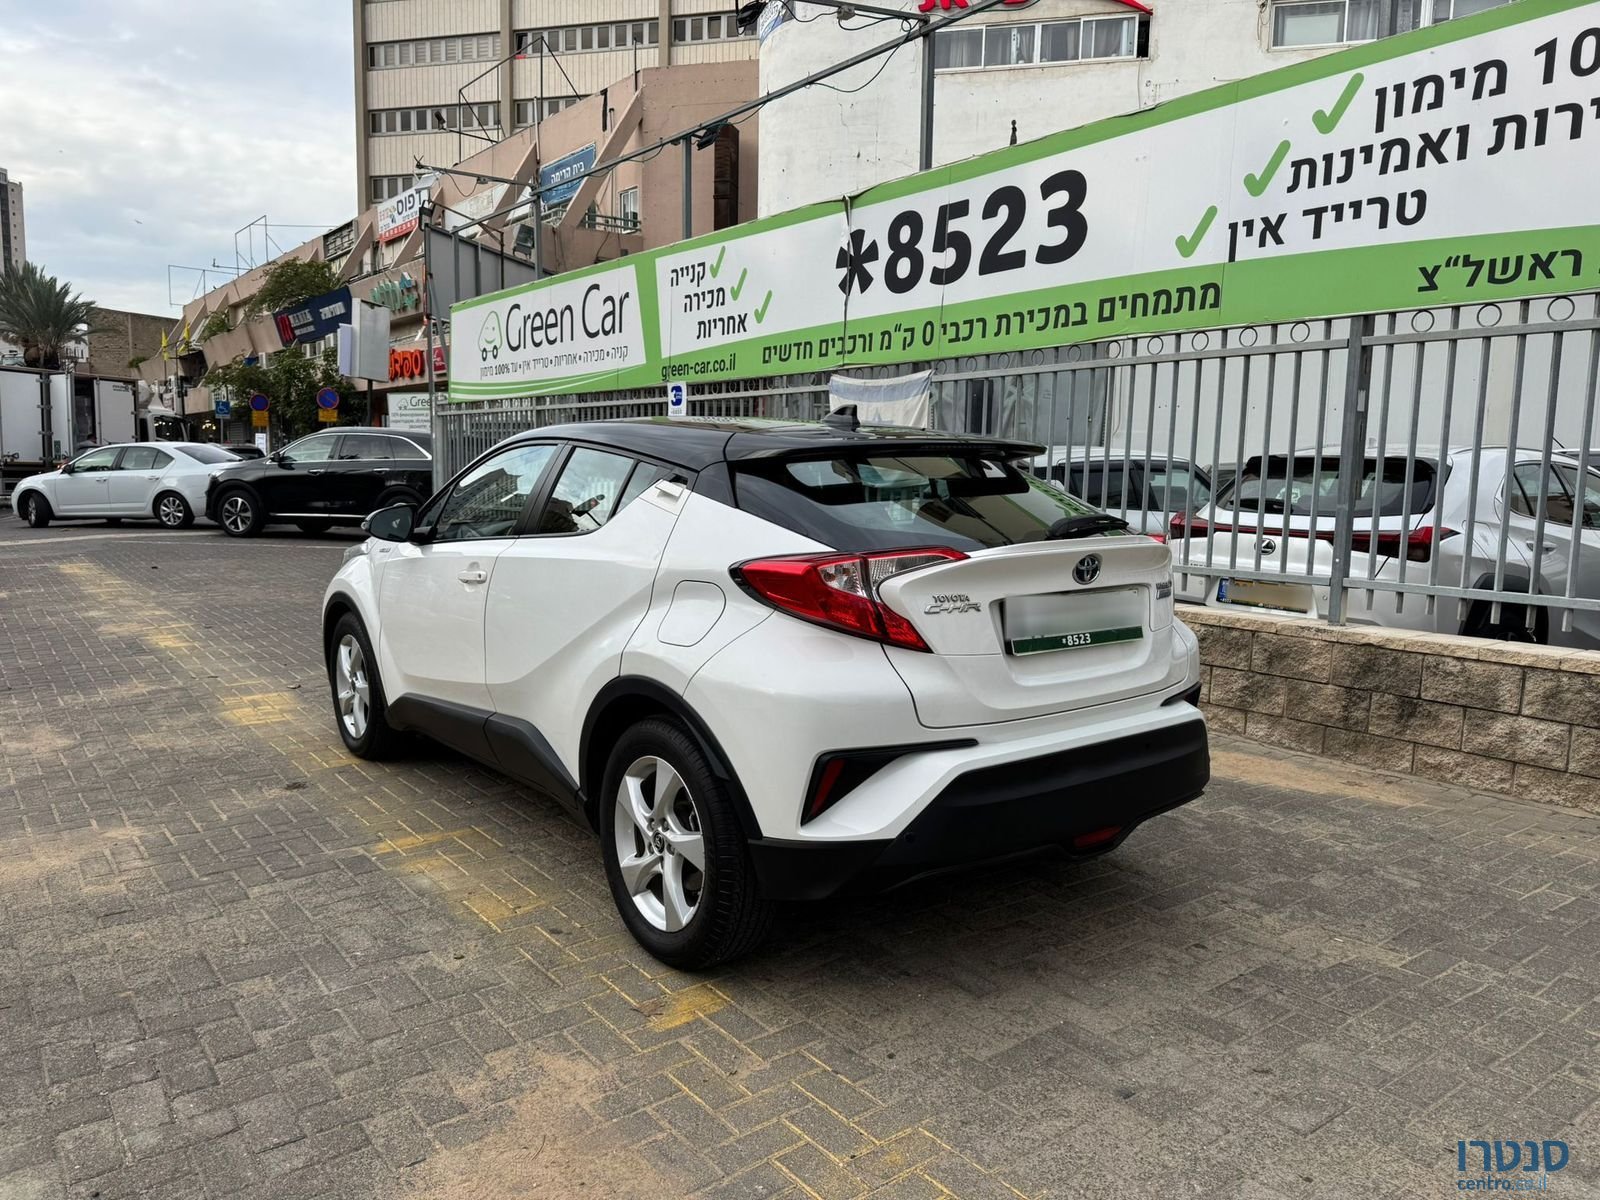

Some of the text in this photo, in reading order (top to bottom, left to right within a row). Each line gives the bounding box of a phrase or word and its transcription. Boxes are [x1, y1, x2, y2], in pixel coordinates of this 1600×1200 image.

[1374, 58, 1508, 133] מימון
[1286, 124, 1470, 194] ואמינות
[1228, 189, 1427, 263] טרייד אין
[670, 261, 706, 287] קנייה
[683, 287, 726, 313] מכירה
[1098, 282, 1221, 322] מתמחים
[506, 283, 629, 351] Green Car
[696, 313, 748, 340] אחריות
[941, 317, 987, 343] רכבי
[994, 302, 1088, 337] במכירת
[762, 341, 813, 364] חדשים
[818, 333, 874, 358] ורכבים
[661, 353, 736, 381] green-car.co.il
[409, 395, 431, 407] Gree
[932, 593, 970, 604] TOYOTA
